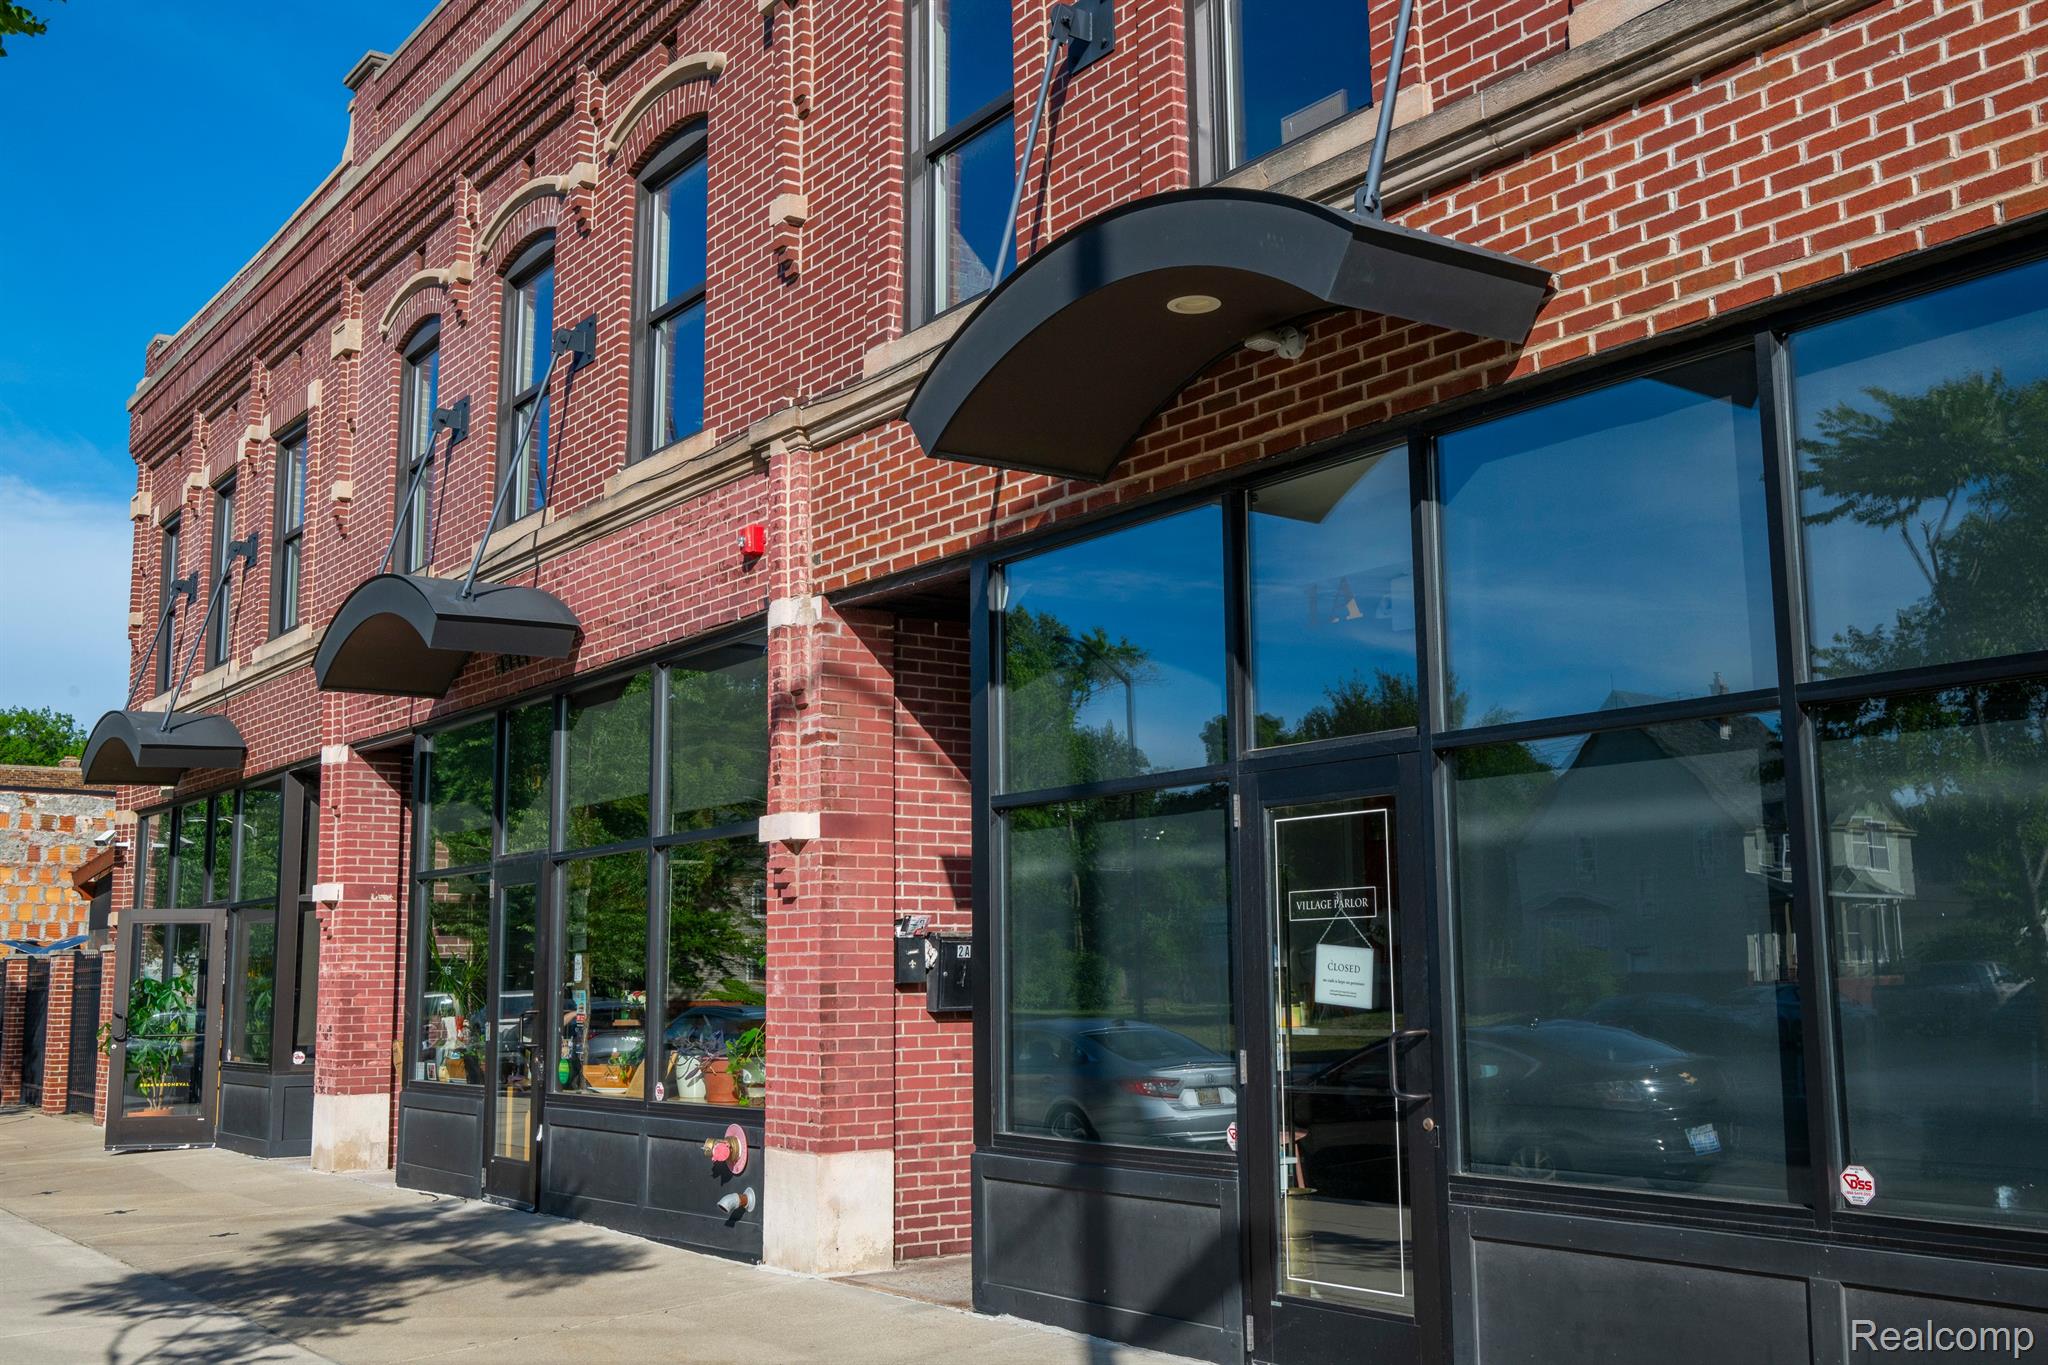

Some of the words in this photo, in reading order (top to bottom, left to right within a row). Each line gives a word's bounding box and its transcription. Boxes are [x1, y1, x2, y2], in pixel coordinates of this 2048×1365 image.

[1296, 899, 1332, 911] VILLAGE
[1333, 896, 1369, 909] PARLOR
[958, 945, 971, 957] 2A
[1327, 962, 1361, 974] CLOSED
